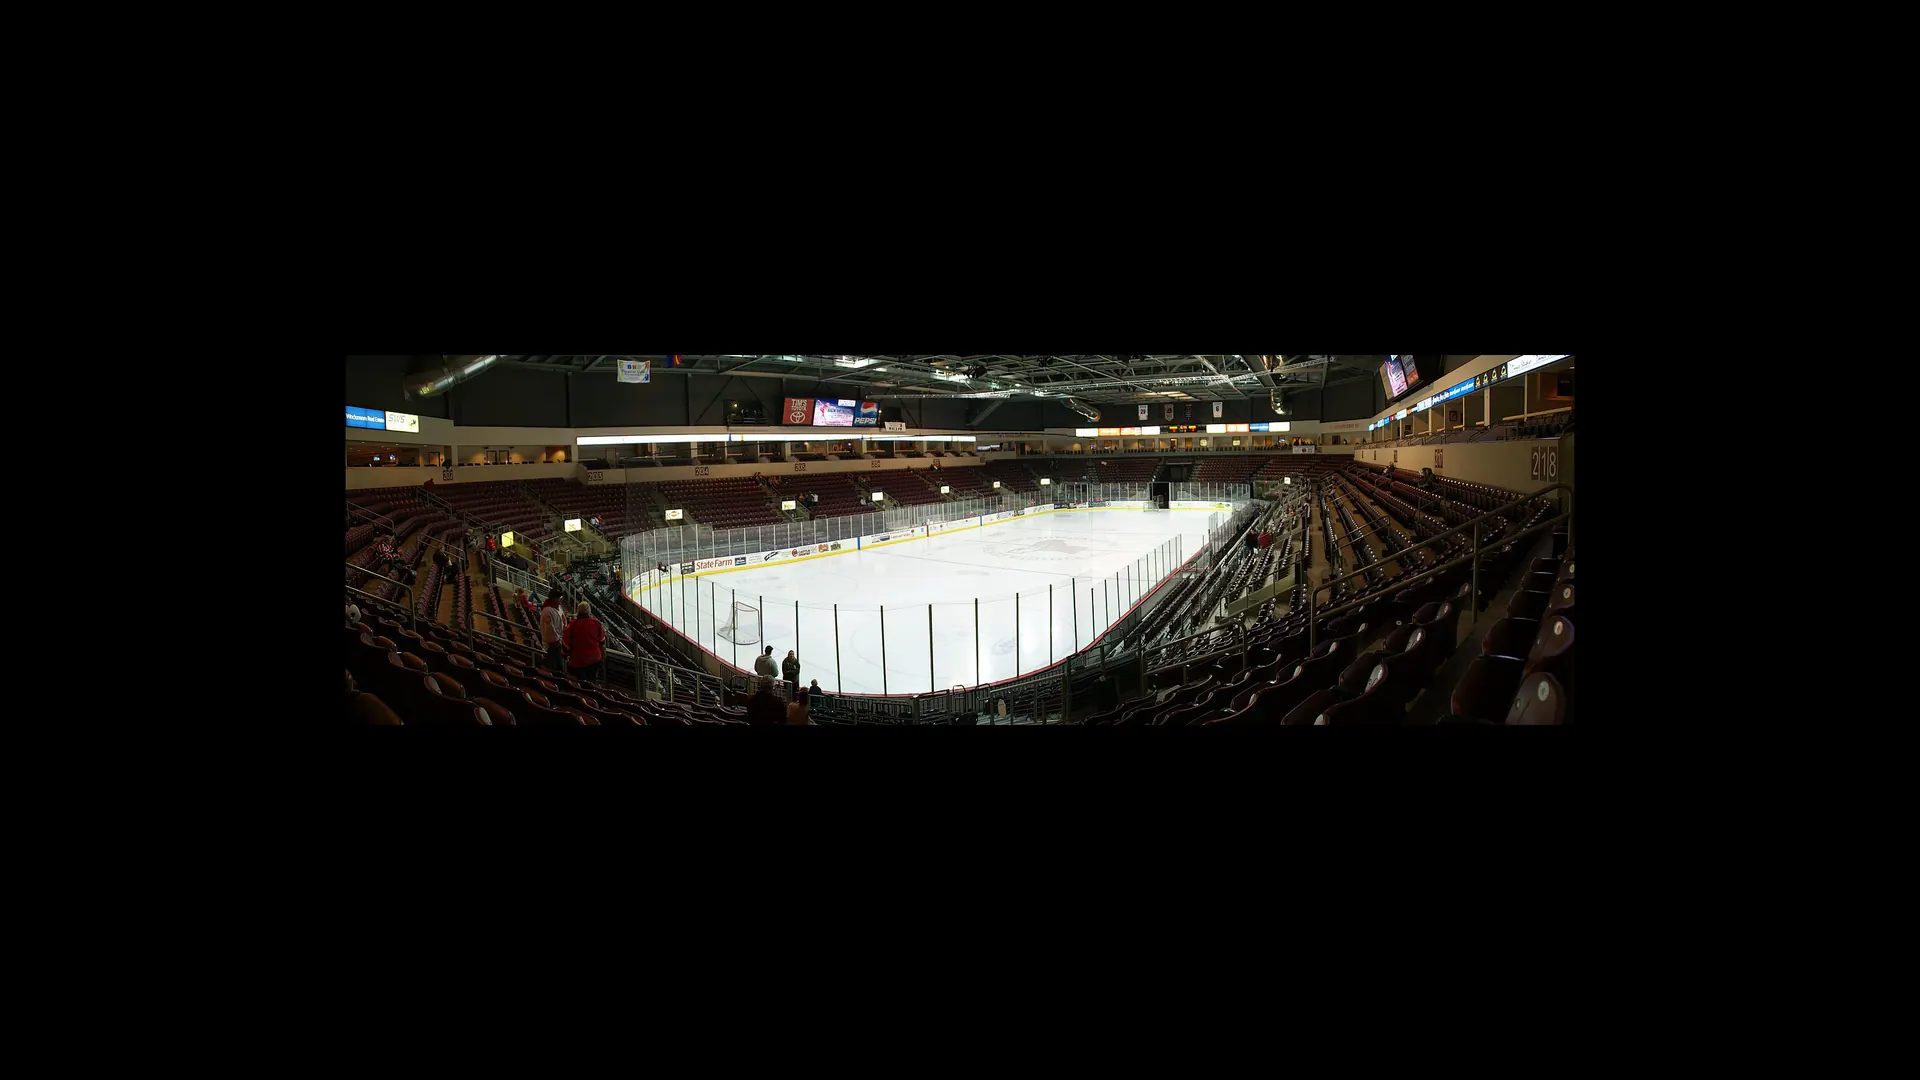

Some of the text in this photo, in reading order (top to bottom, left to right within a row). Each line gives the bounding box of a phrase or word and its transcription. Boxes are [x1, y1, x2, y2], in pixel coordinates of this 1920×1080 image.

[854, 417, 877, 425] PEPSI
[1532, 451, 1557, 477] 218
[588, 472, 603, 480] 203
[696, 561, 714, 570] State
[714, 559, 733, 568] Farm
